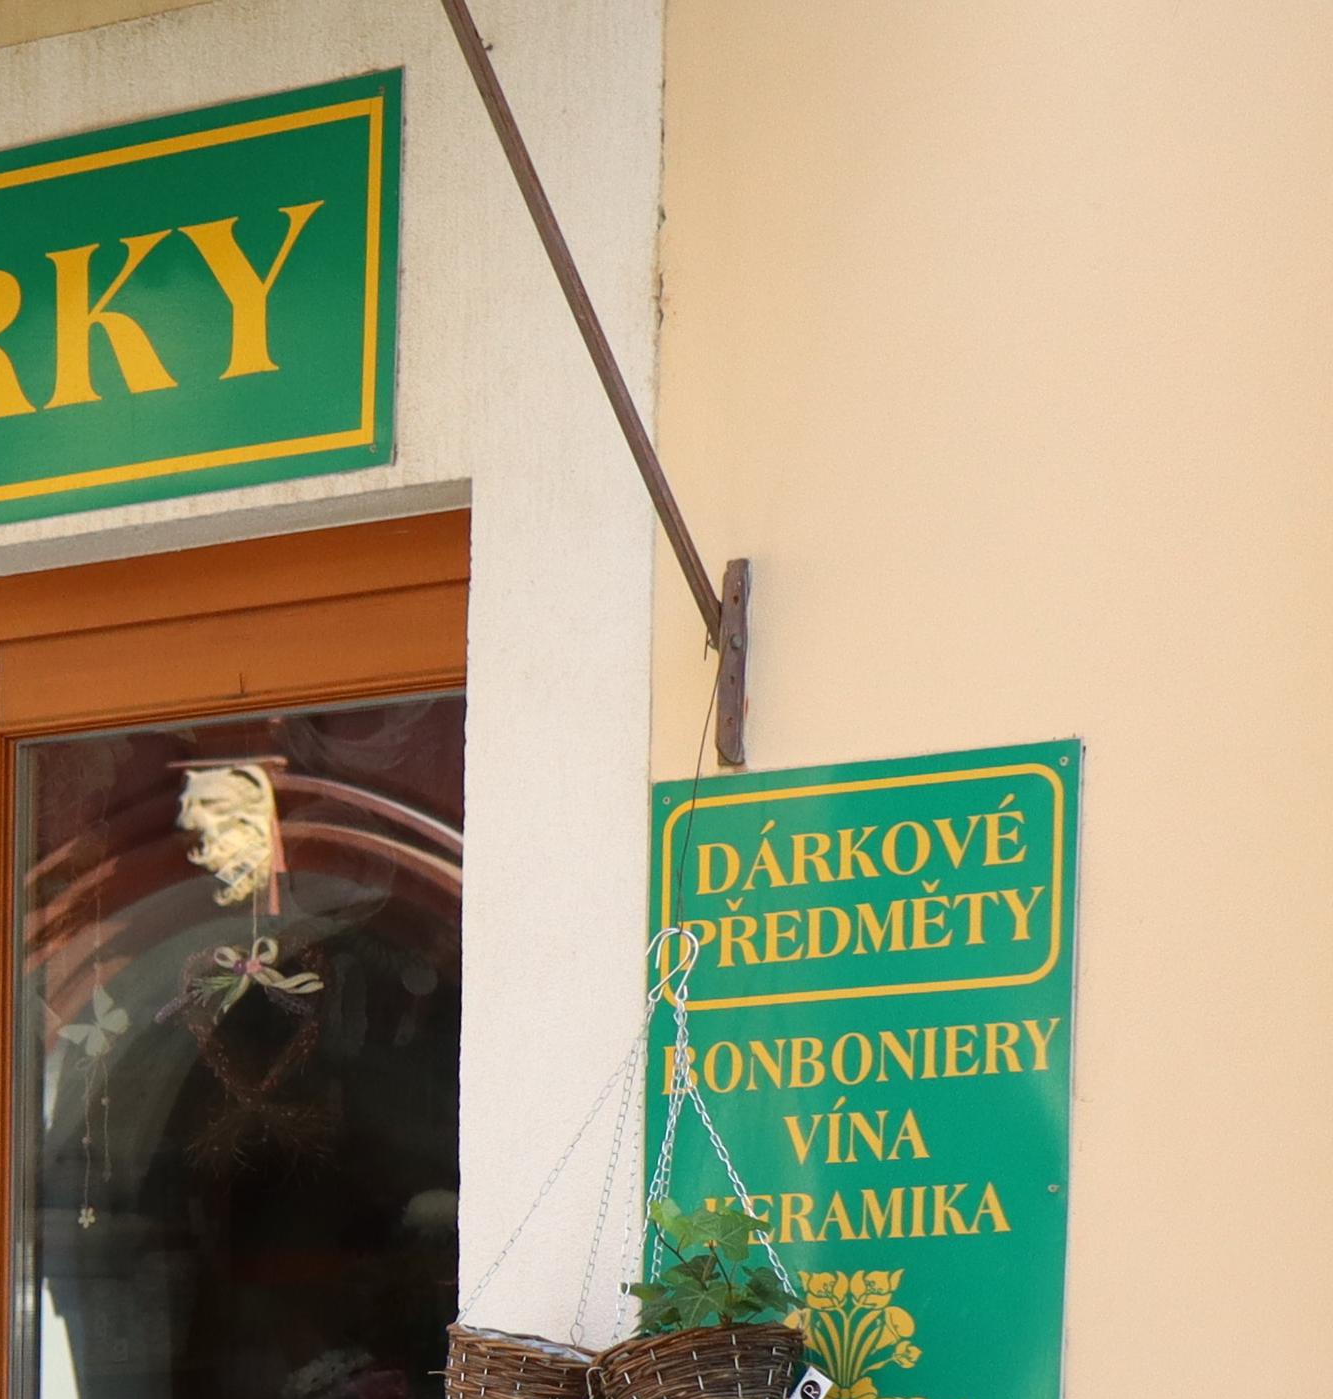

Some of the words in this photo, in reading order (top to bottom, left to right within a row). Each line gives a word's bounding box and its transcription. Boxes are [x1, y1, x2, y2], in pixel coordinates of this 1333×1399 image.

[695, 793, 1027, 896] DÁRKOVÉ
[680, 879, 1046, 971] PŘEDMĚTY
[784, 1095, 930, 1165] VÍNA
